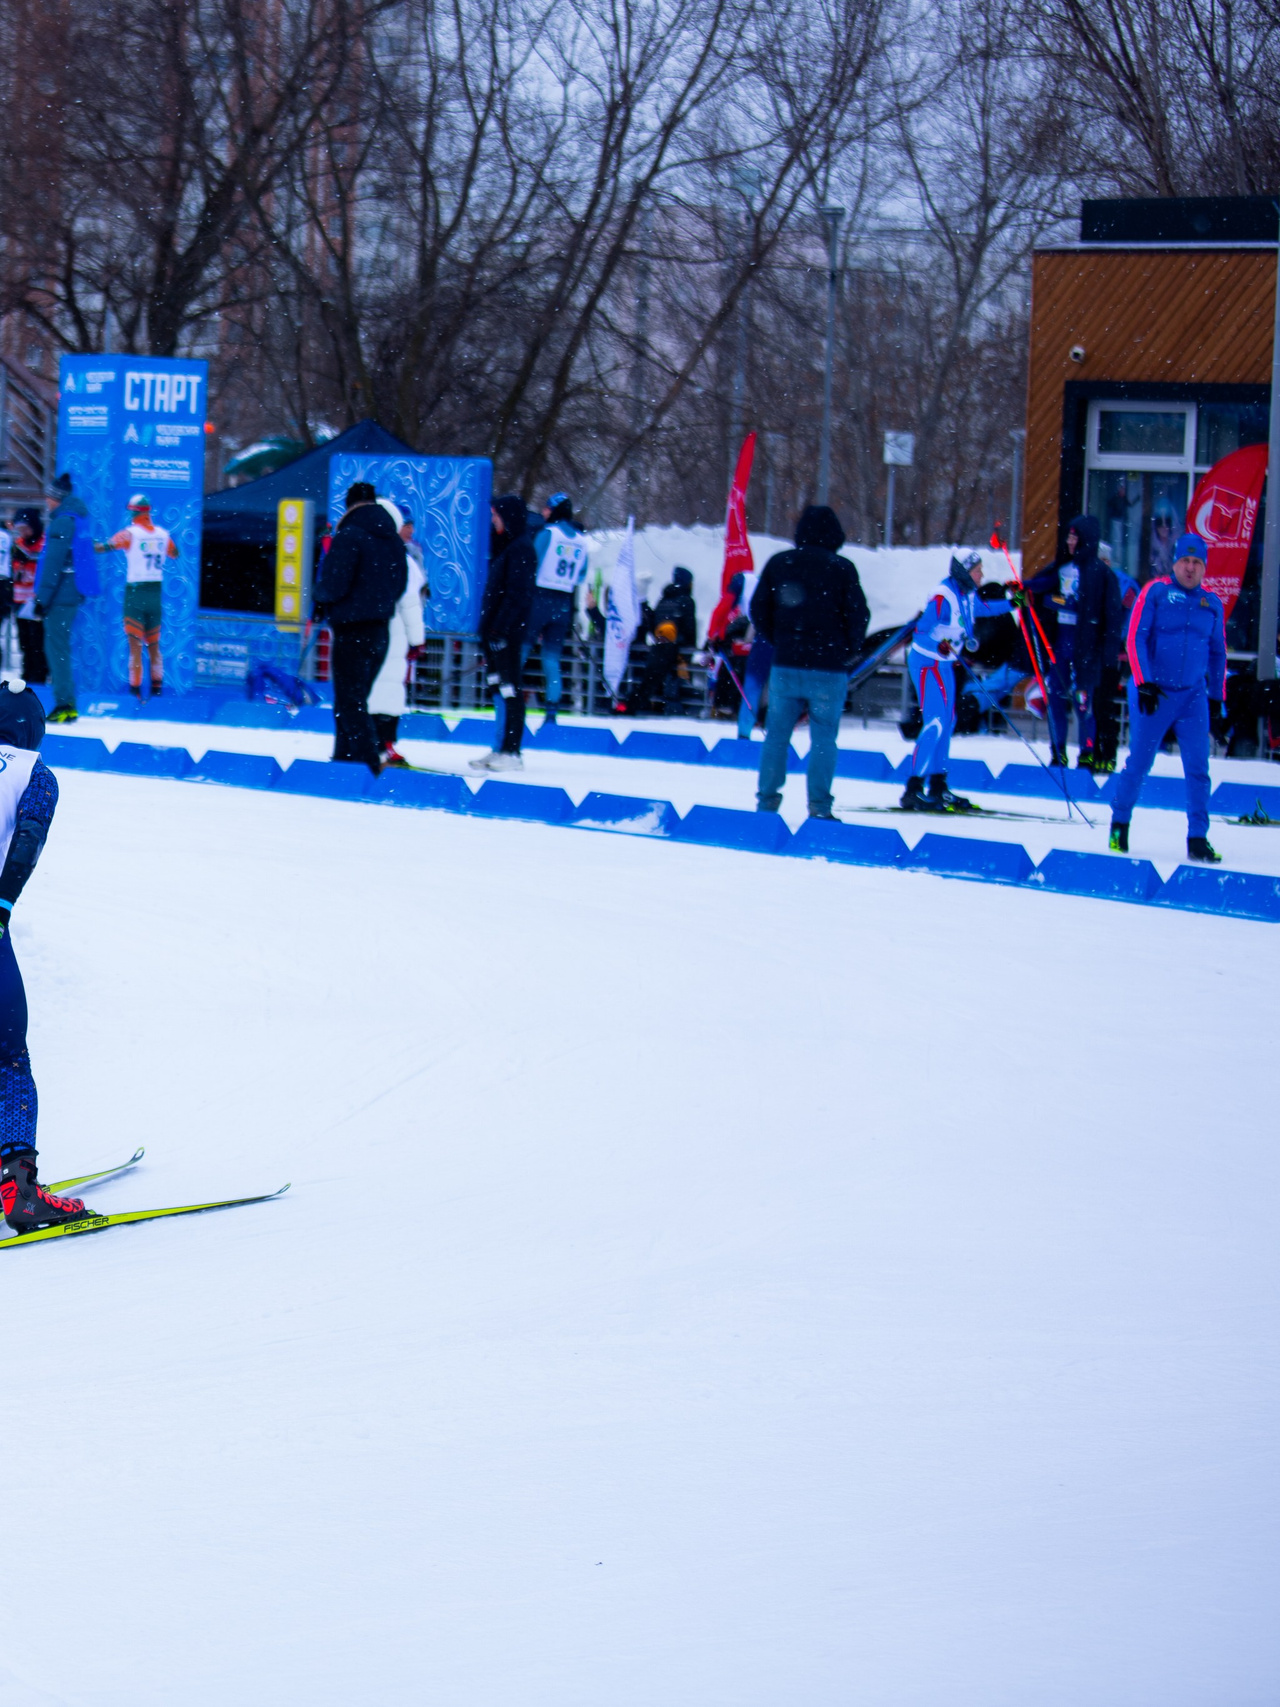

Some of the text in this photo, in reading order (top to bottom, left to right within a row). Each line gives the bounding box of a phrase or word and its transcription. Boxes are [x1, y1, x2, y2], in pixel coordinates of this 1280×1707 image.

[124, 371, 202, 414] СТАРТ
[556, 559, 576, 579] 81
[64, 1217, 110, 1233] FISCHER
